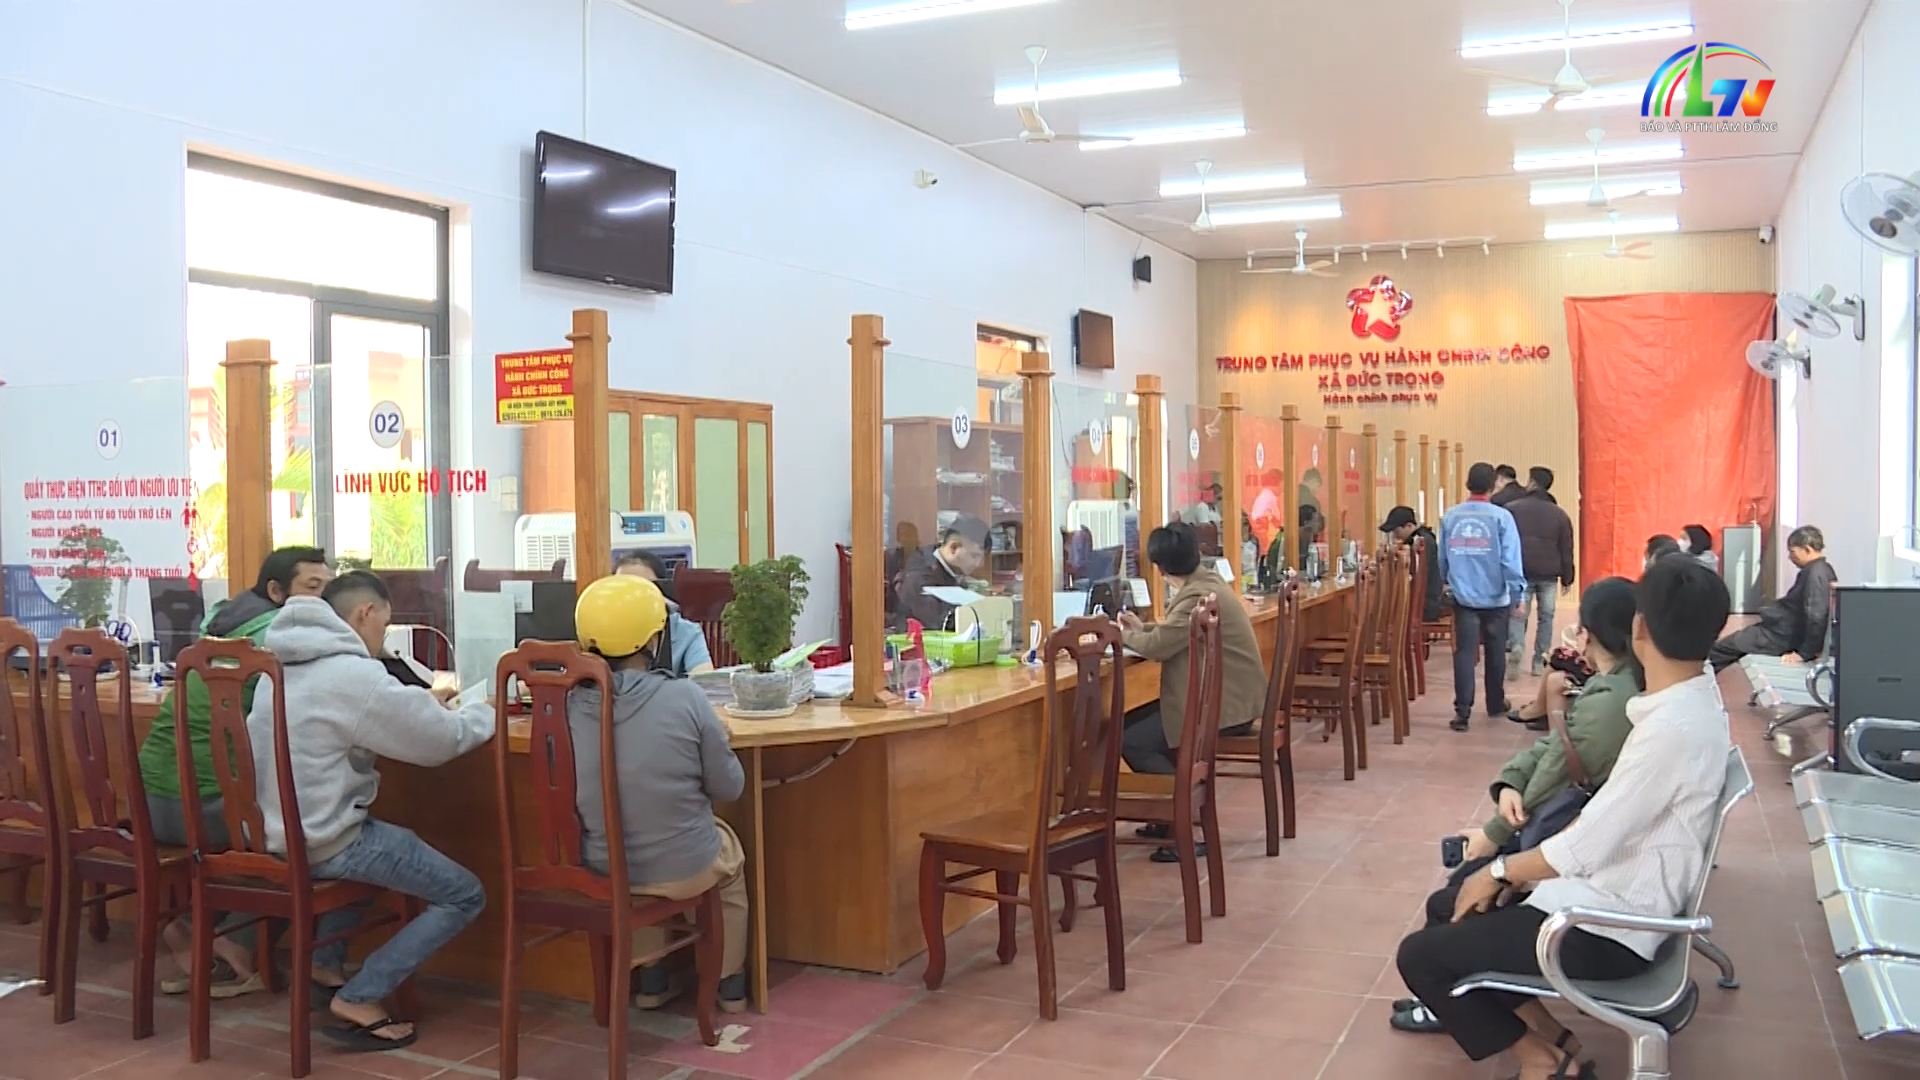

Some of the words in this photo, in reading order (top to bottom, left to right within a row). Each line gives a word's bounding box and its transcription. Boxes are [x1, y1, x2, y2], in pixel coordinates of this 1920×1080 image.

[501, 358, 524, 369] TRUNG
[1216, 355, 1267, 370] TRUNG
[1271, 352, 1304, 369] TÂM
[1308, 352, 1353, 369] PHỤC
[1359, 351, 1380, 368] VỤ
[1385, 347, 1432, 364] HÀNH
[1318, 371, 1342, 388] XÃ
[1346, 370, 1382, 387] ĐỨC
[1386, 370, 1445, 389] TRỌNG
[374, 413, 400, 434] 02
[955, 415, 968, 434] 03
[99, 428, 118, 447] 01
[88, 480, 107, 498] TTHC
[377, 468, 411, 497] VỰC
[418, 466, 441, 497] HỘ
[447, 469, 487, 498] TỊCH
[57, 509, 72, 520] CAO
[156, 506, 172, 519] LÊN
